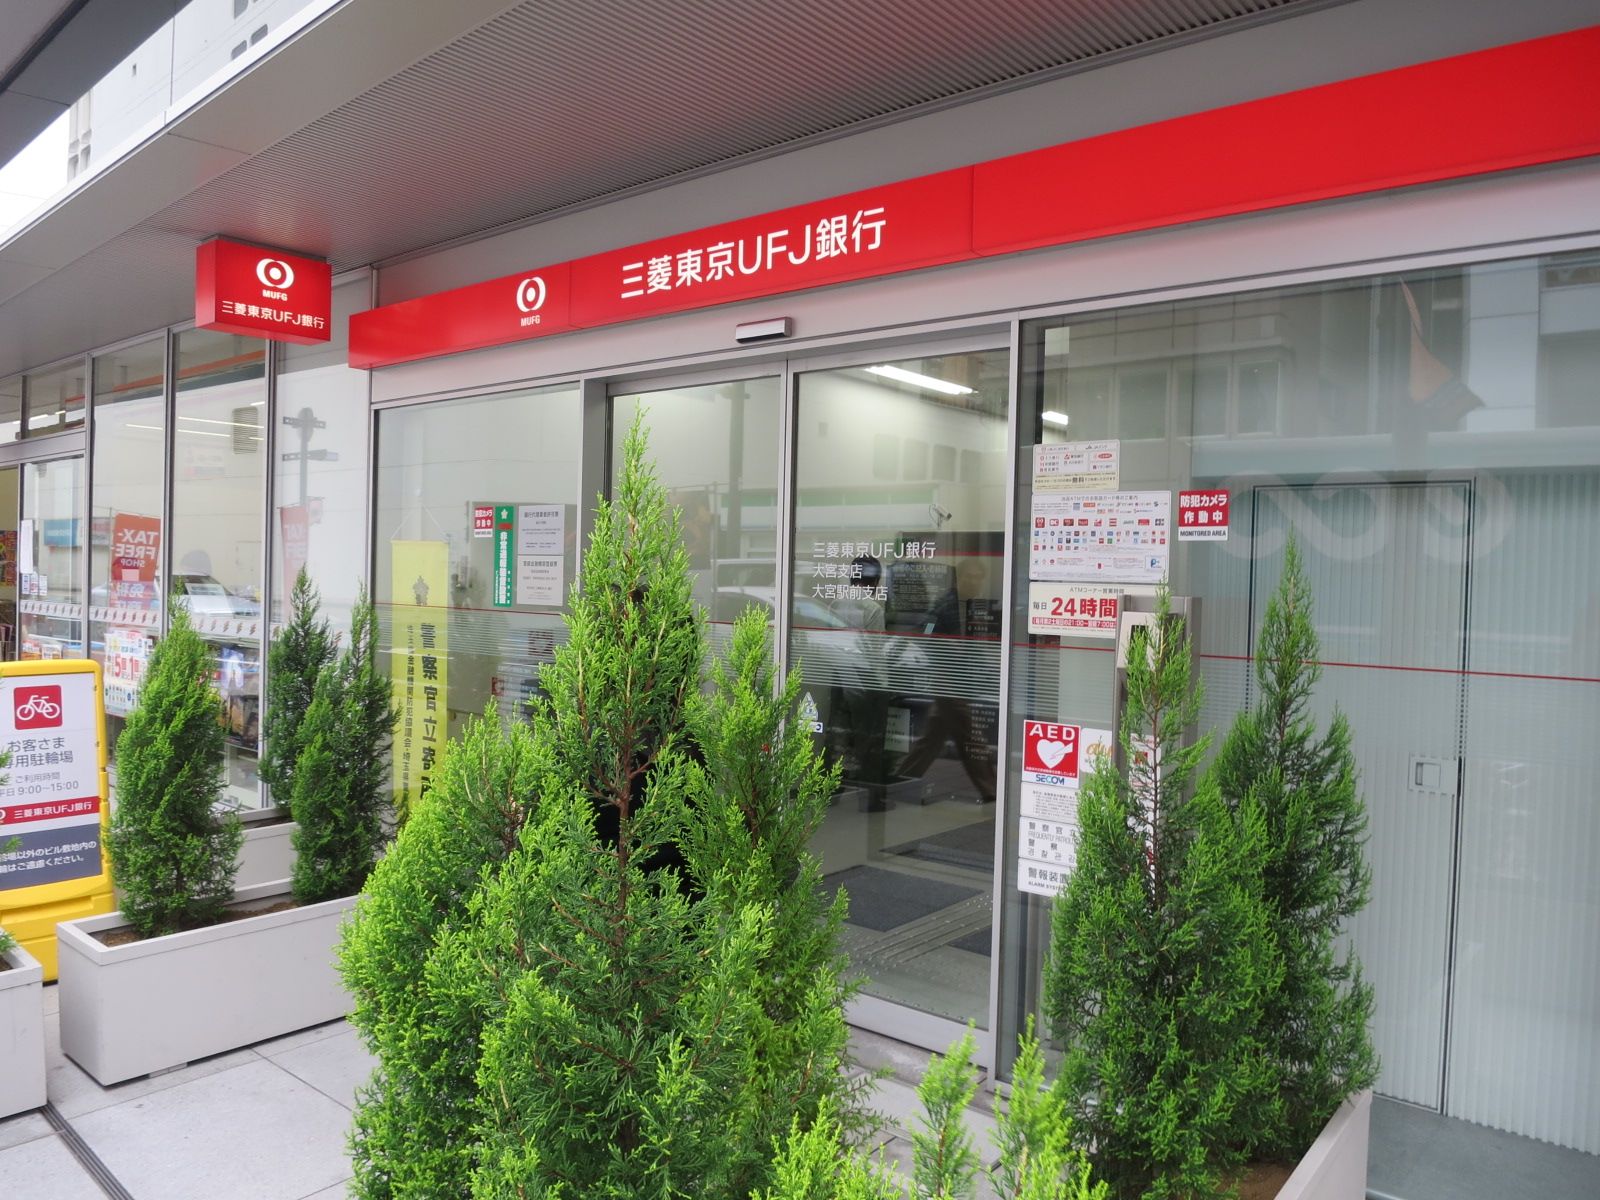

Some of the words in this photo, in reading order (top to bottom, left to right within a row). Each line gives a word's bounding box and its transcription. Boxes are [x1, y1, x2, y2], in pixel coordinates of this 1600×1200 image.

[621, 207, 887, 299] 三菱東京UFJ銀行
[262, 289, 288, 302] MUFG
[222, 300, 325, 330] 三菱東京UFJ銀行
[520, 314, 541, 327] MUFG
[1180, 494, 1228, 508] 防犯カメラ
[1184, 510, 1223, 524] 作動中
[812, 541, 936, 559] 三菱東京UFJ銀行
[812, 563, 863, 579] 大宮支店
[812, 583, 888, 601] 大宮駅前支店
[1051, 597, 1118, 618] 24時間
[1029, 723, 1076, 741] AED
[7, 737, 65, 753] お客さま
[15, 772, 60, 785] ご利用時間
[1036, 773, 1065, 786] SECOM
[14, 801, 92, 820] 三菱東京UFJ銀行
